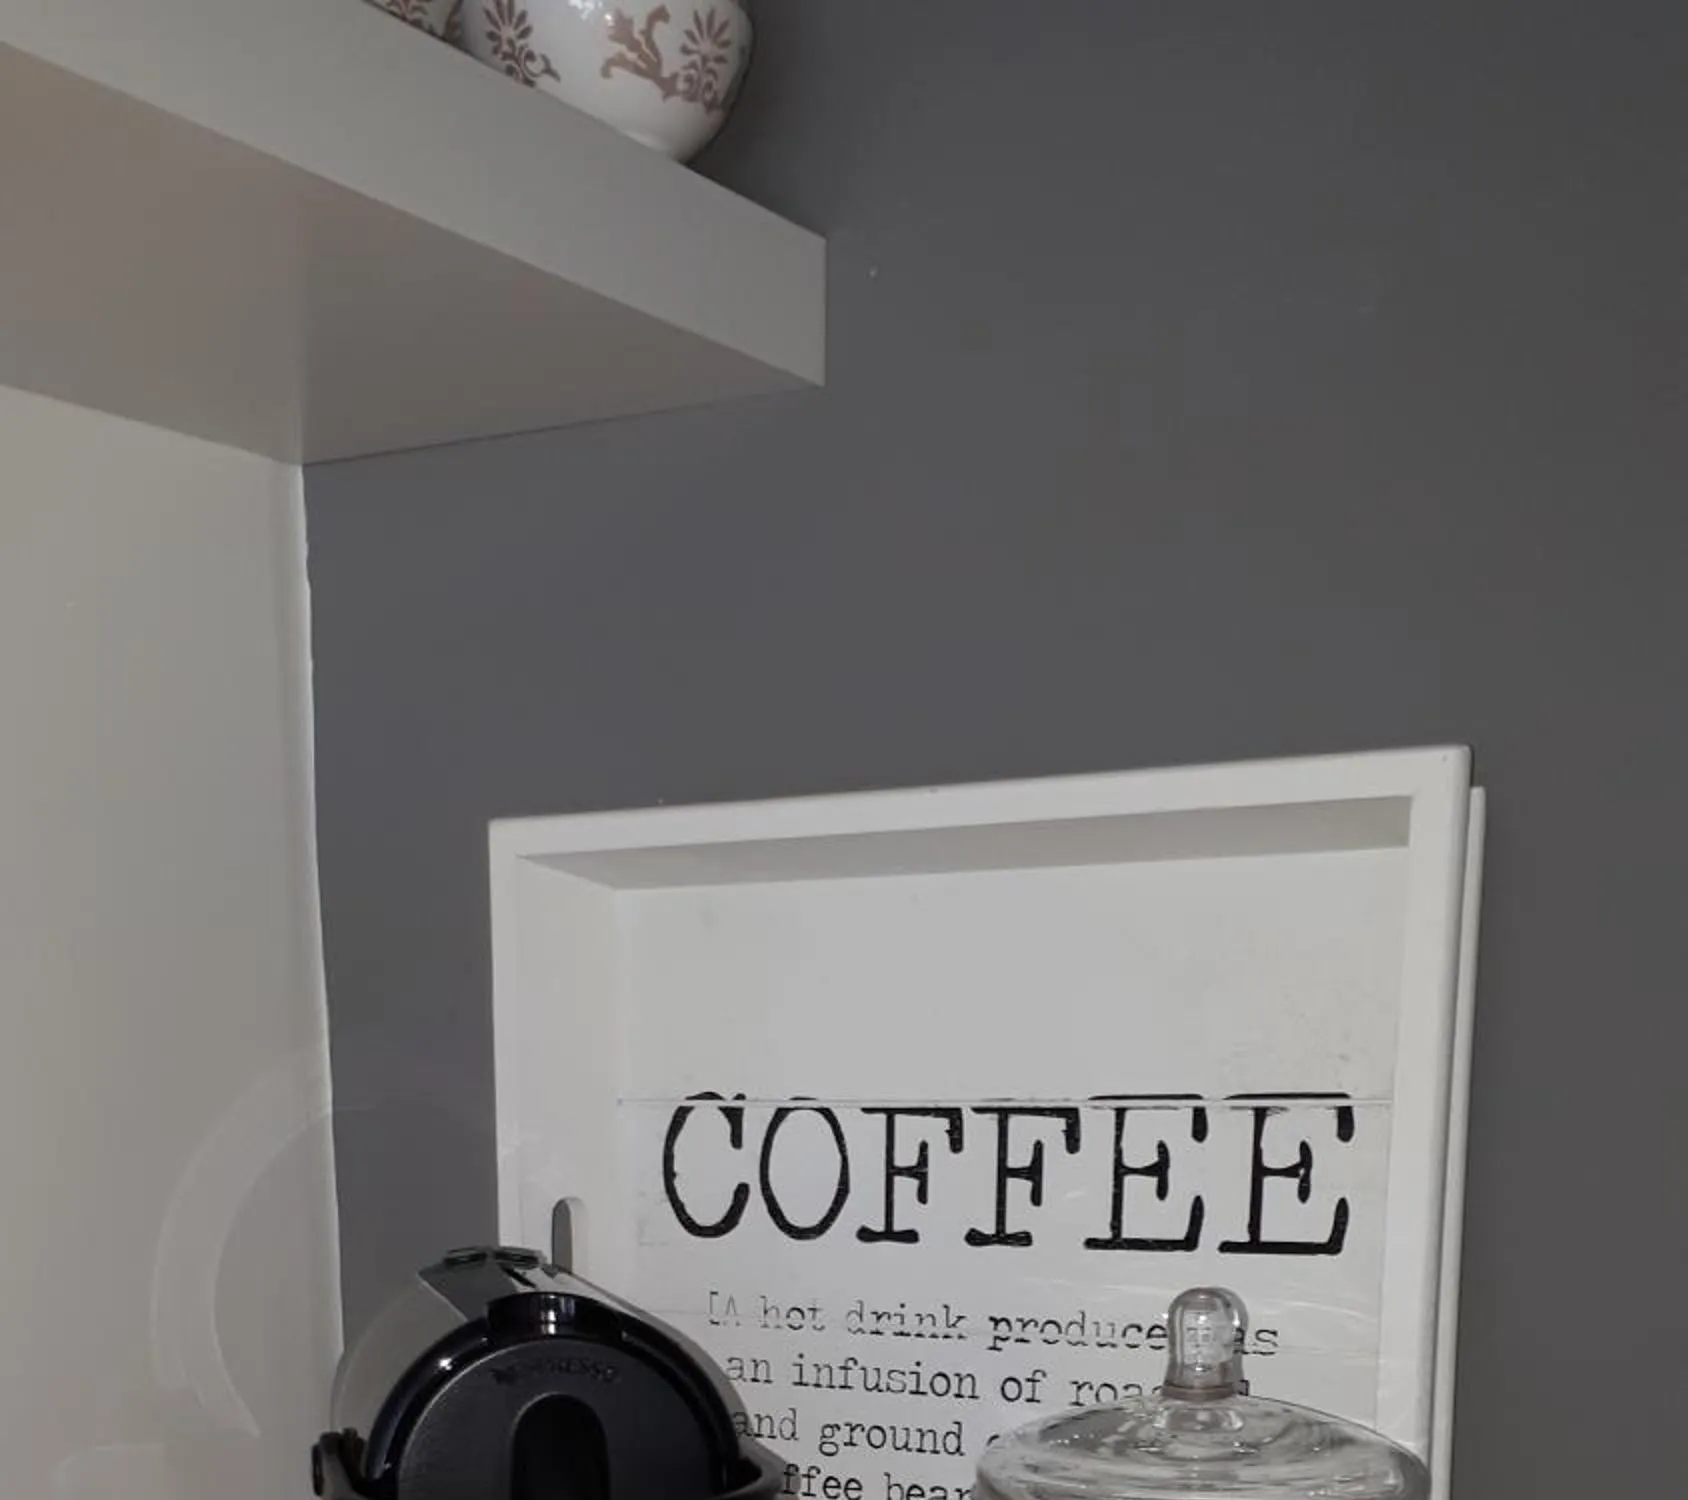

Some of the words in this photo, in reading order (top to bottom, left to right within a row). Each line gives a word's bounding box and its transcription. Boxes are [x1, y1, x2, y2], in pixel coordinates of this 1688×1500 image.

[664, 1091, 1354, 1255] COFFEE
[760, 1295, 826, 1331] hot
[846, 1299, 968, 1340] drink
[986, 1310, 1168, 1352] produce
[725, 1355, 774, 1385] an
[791, 1352, 981, 1400] infusion
[1000, 1368, 1047, 1404] of
[732, 1407, 800, 1441] and
[818, 1421, 966, 1457] ground
